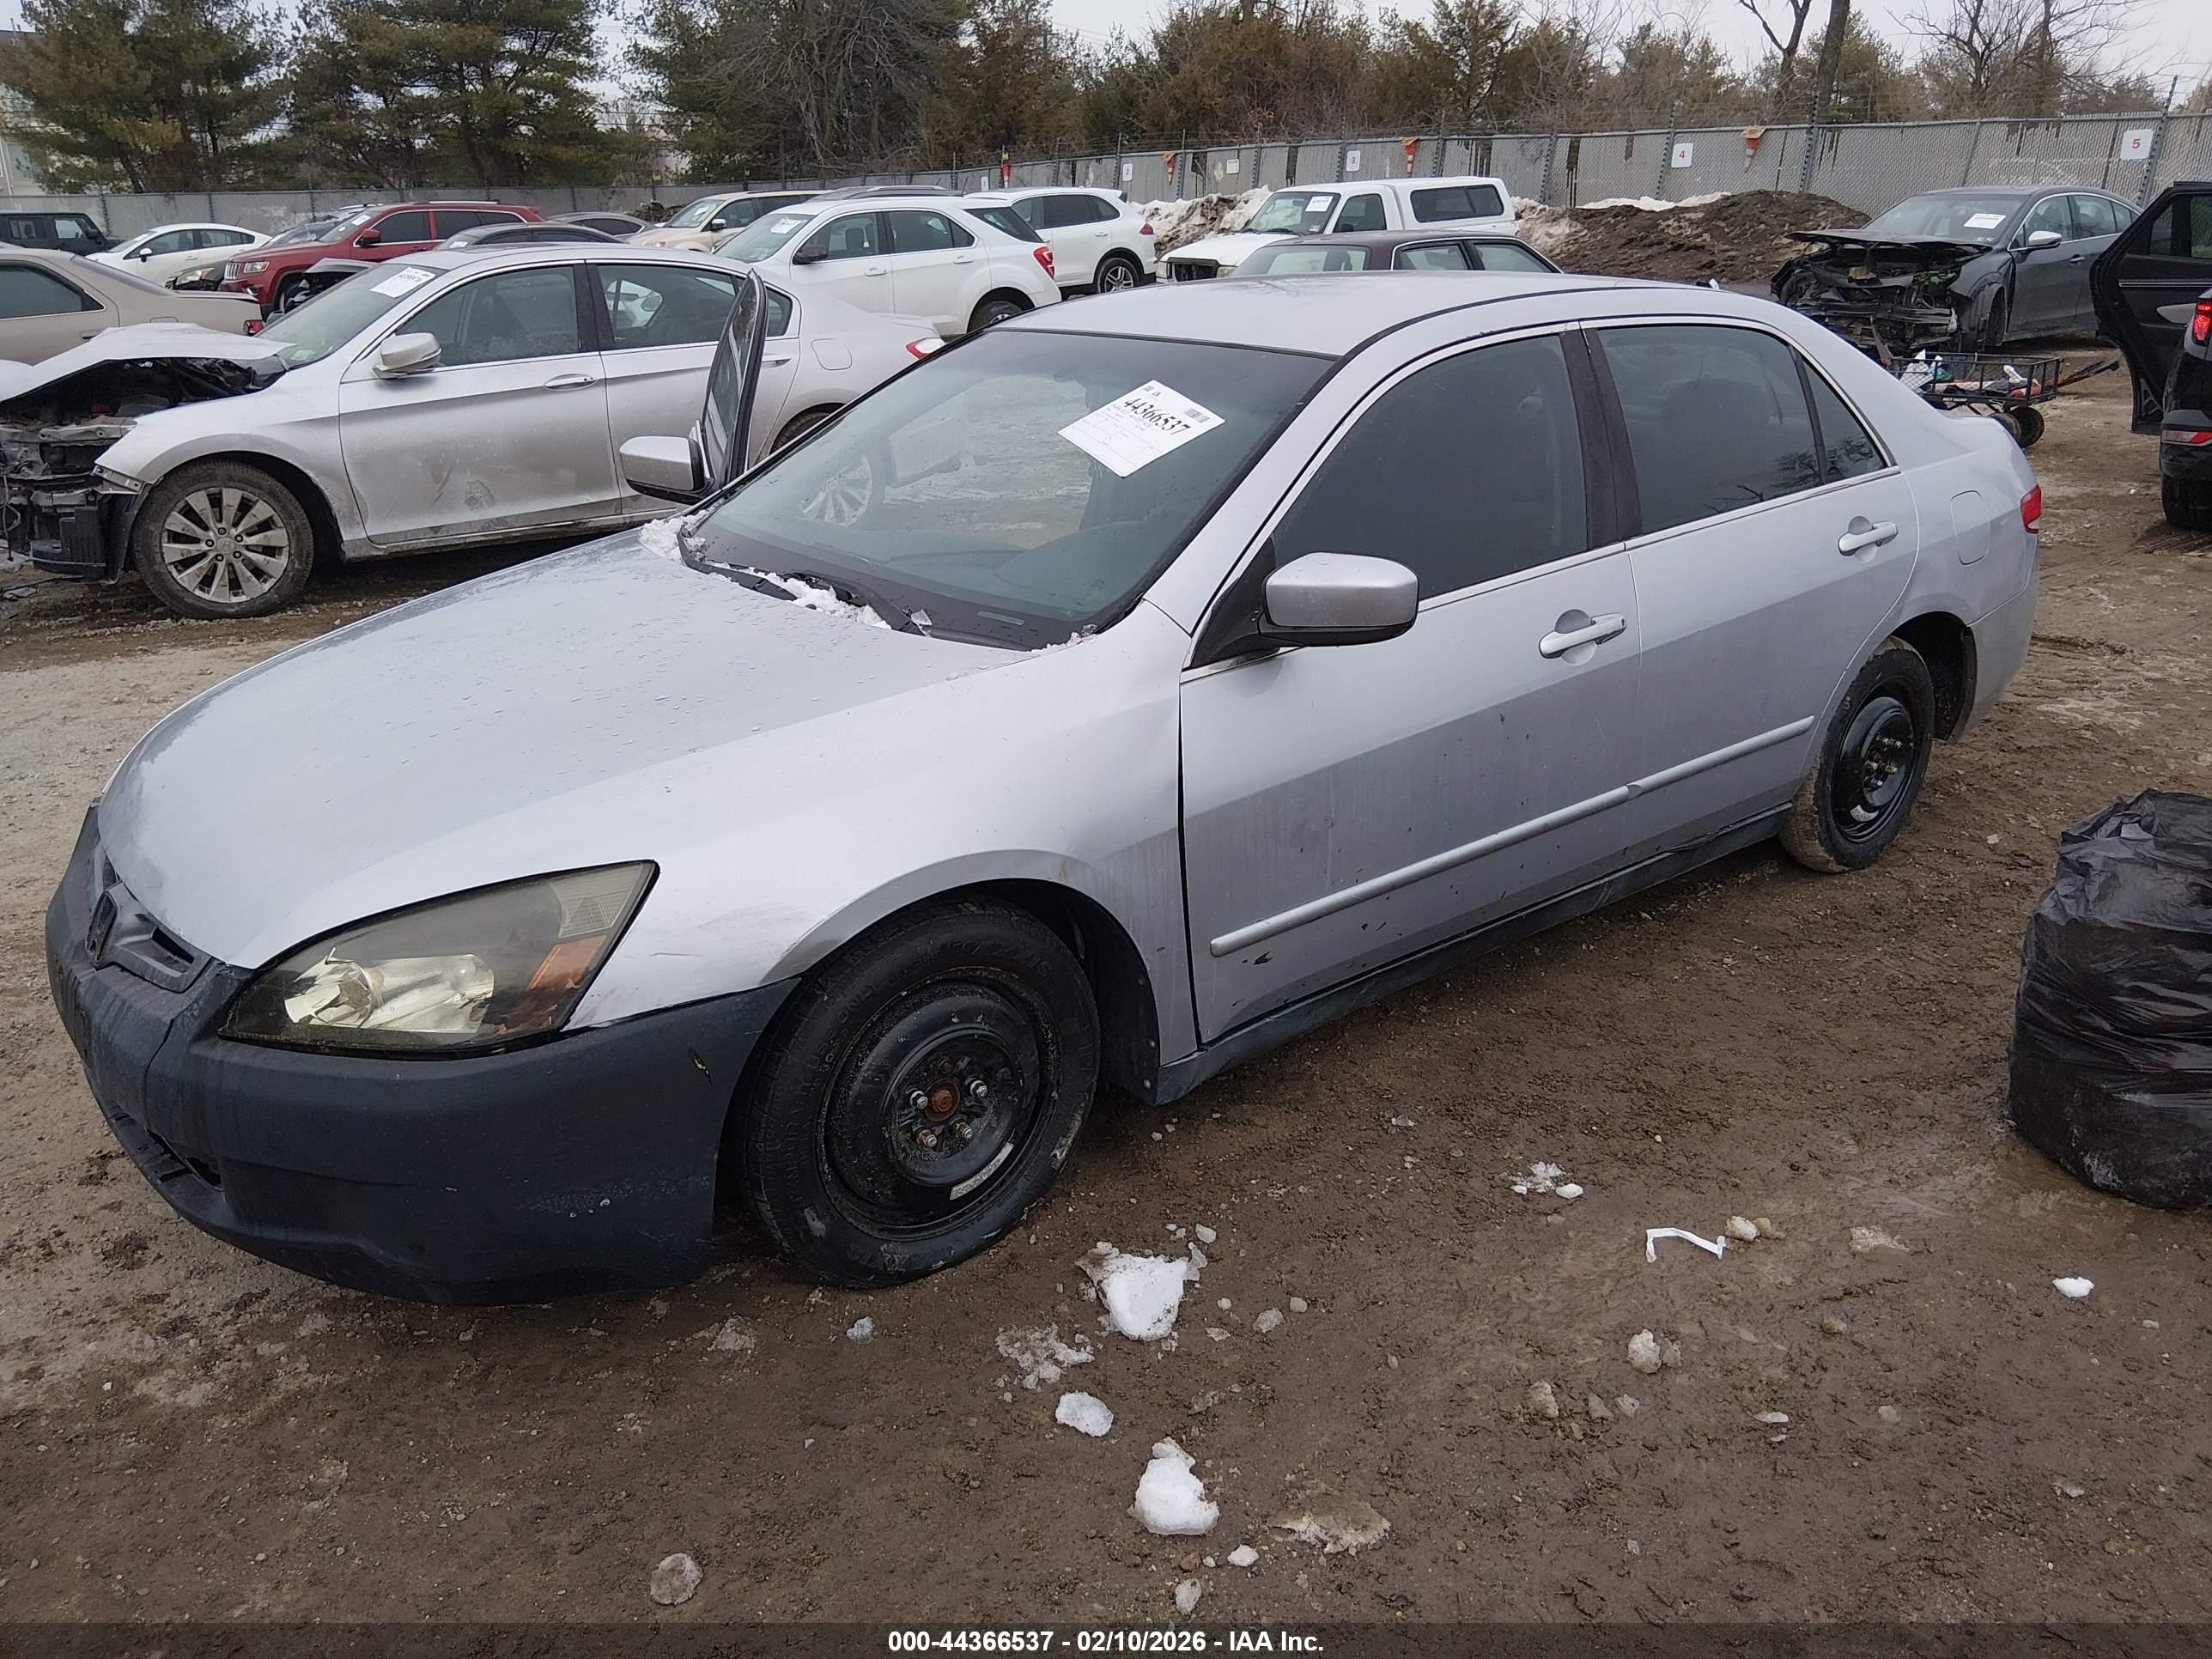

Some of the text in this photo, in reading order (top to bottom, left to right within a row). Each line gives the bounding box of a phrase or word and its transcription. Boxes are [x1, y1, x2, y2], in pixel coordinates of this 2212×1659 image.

[2132, 138, 2141, 149] 5
[1679, 150, 1685, 159] 4
[1123, 398, 1191, 434] 44366537
